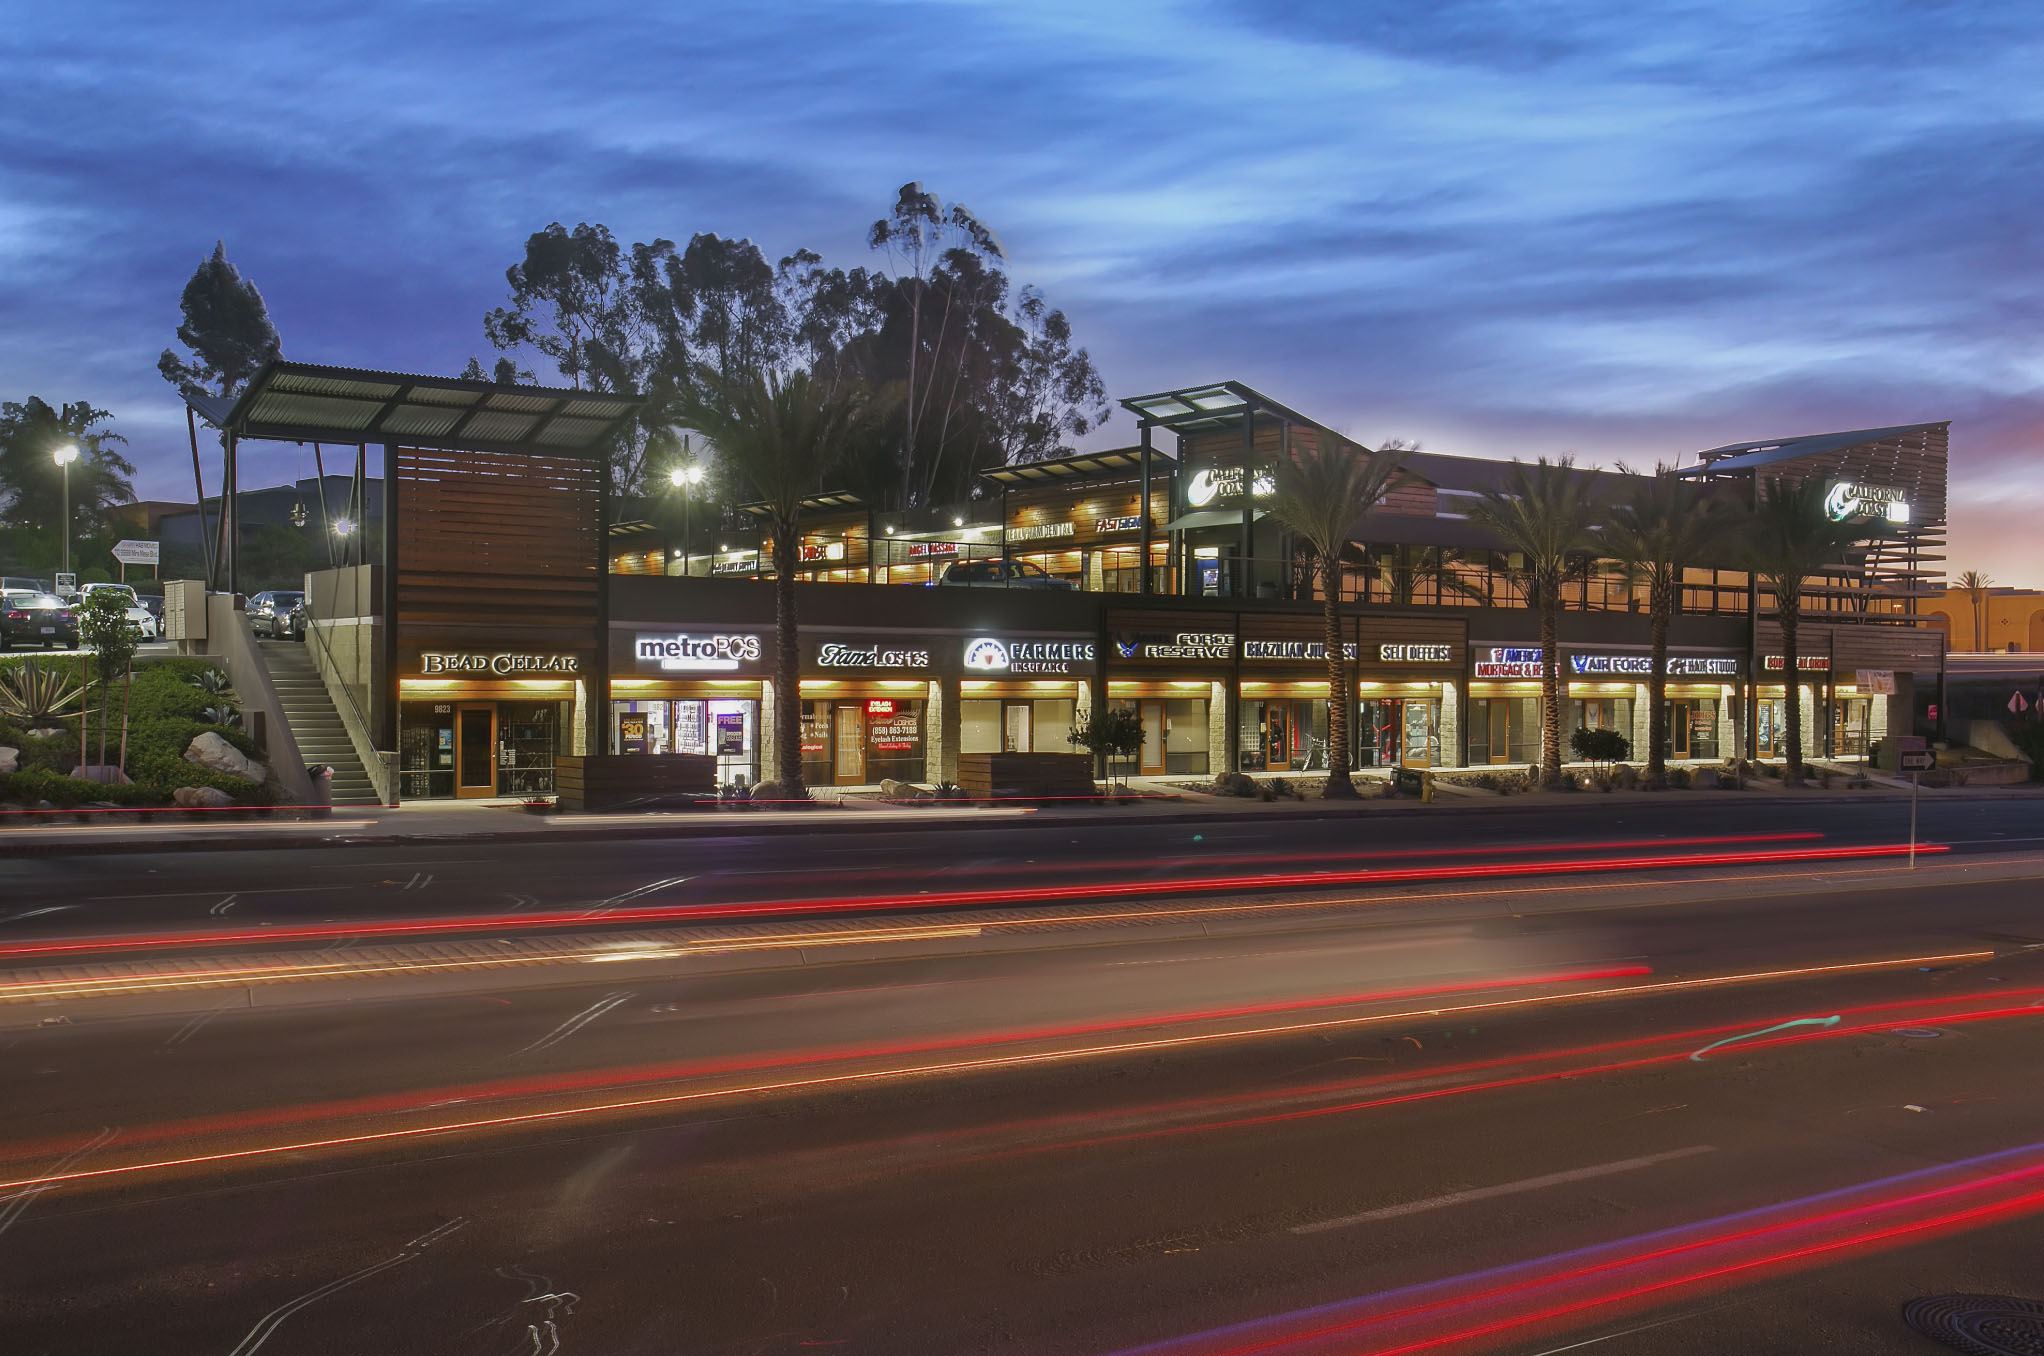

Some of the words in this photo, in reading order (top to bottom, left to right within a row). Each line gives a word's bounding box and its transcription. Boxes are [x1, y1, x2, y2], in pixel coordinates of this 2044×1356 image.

[638, 634, 761, 660] metroPCS
[1177, 633, 1235, 645] FORCE
[1009, 643, 1096, 660] FARMERS
[1144, 645, 1230, 658] RESERVE
[1244, 641, 1303, 659] BRAZILIAN
[1380, 644, 1405, 661] SELF
[1407, 645, 1452, 662] DEFENSE
[422, 653, 490, 674] BEAD
[492, 653, 578, 675] CELLAR
[1010, 662, 1069, 673] INSURANCE
[1475, 662, 1523, 678] MORTGAGE
[1523, 662, 1534, 678] &
[1587, 656, 1610, 672] AIR
[1686, 658, 1707, 674] HAIR
[1707, 658, 1737, 675] STUDIO
[434, 704, 451, 714] 9823
[717, 715, 742, 725] FREE
[871, 736, 891, 744] Eyelash
